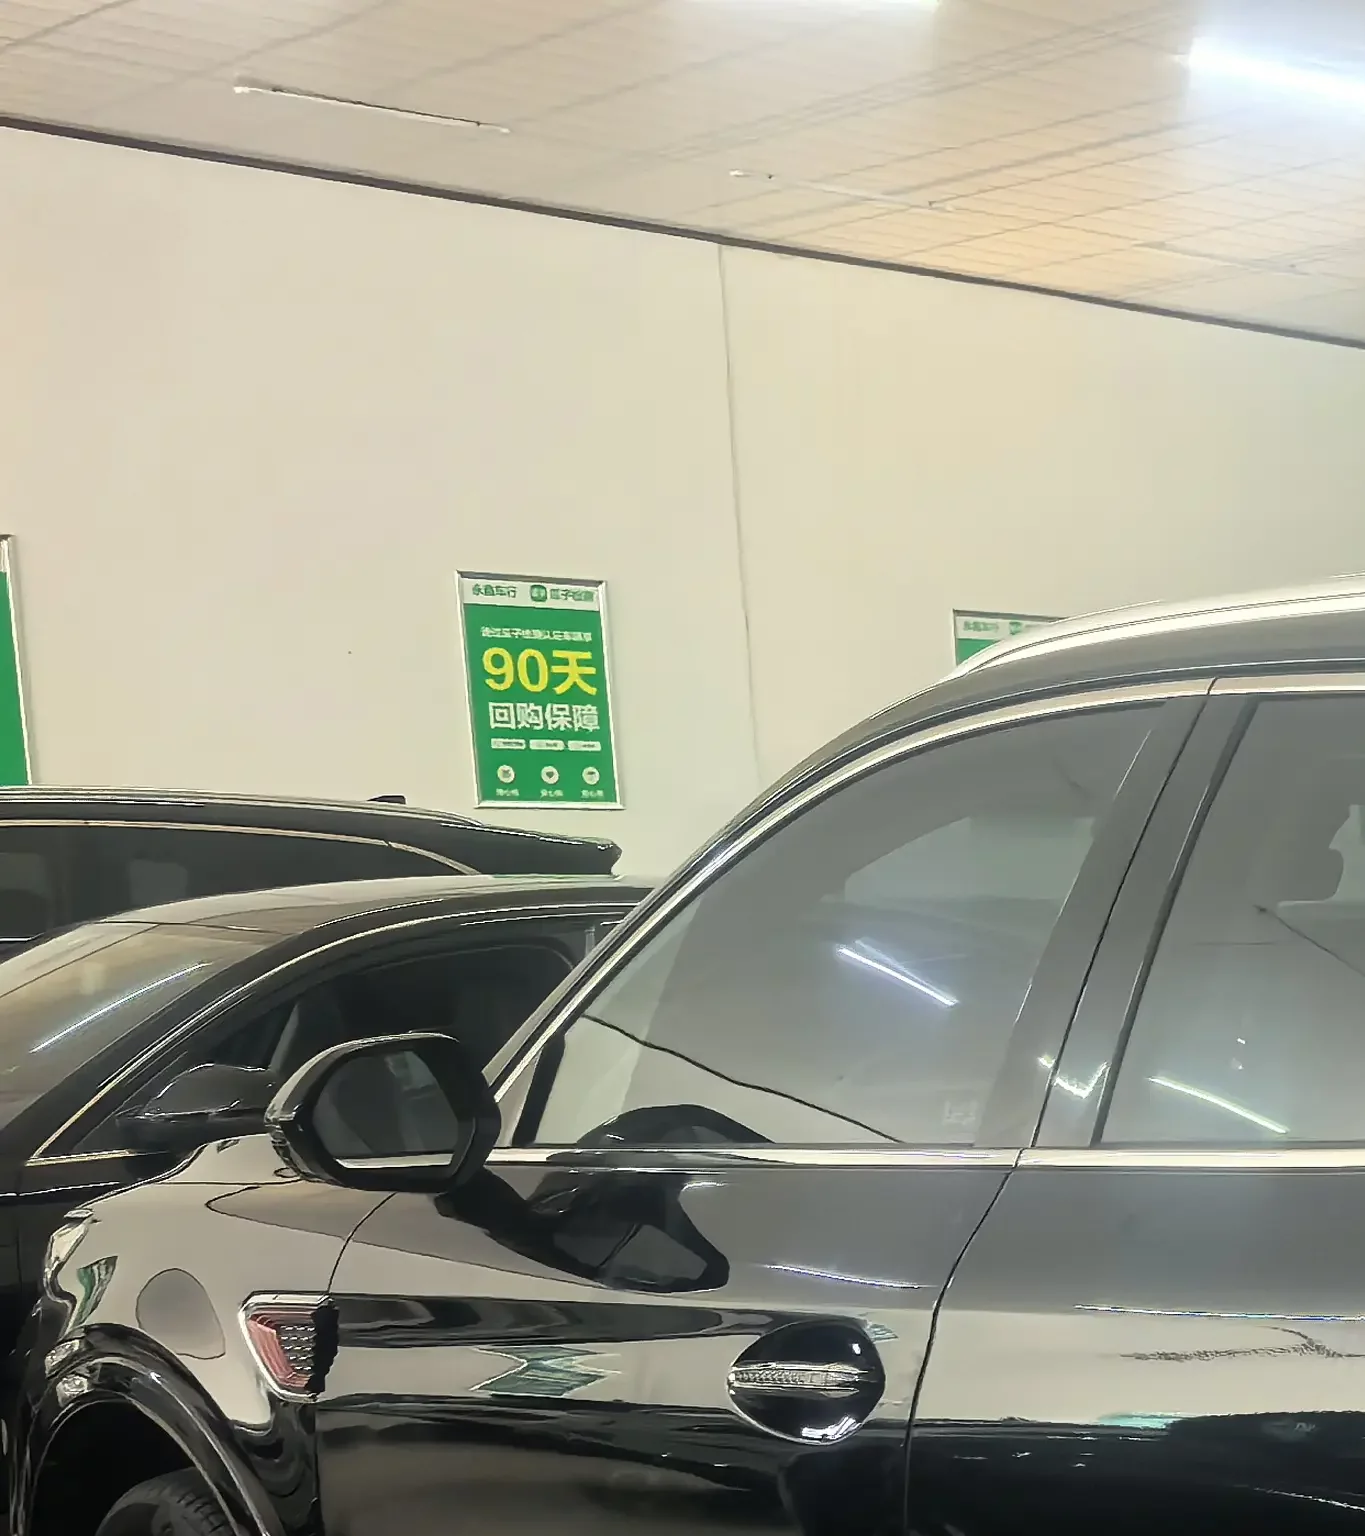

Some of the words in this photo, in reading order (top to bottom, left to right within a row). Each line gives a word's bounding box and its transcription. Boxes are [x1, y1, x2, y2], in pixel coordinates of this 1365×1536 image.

[482, 647, 598, 695] 90天
[488, 702, 600, 732] 回购保障
